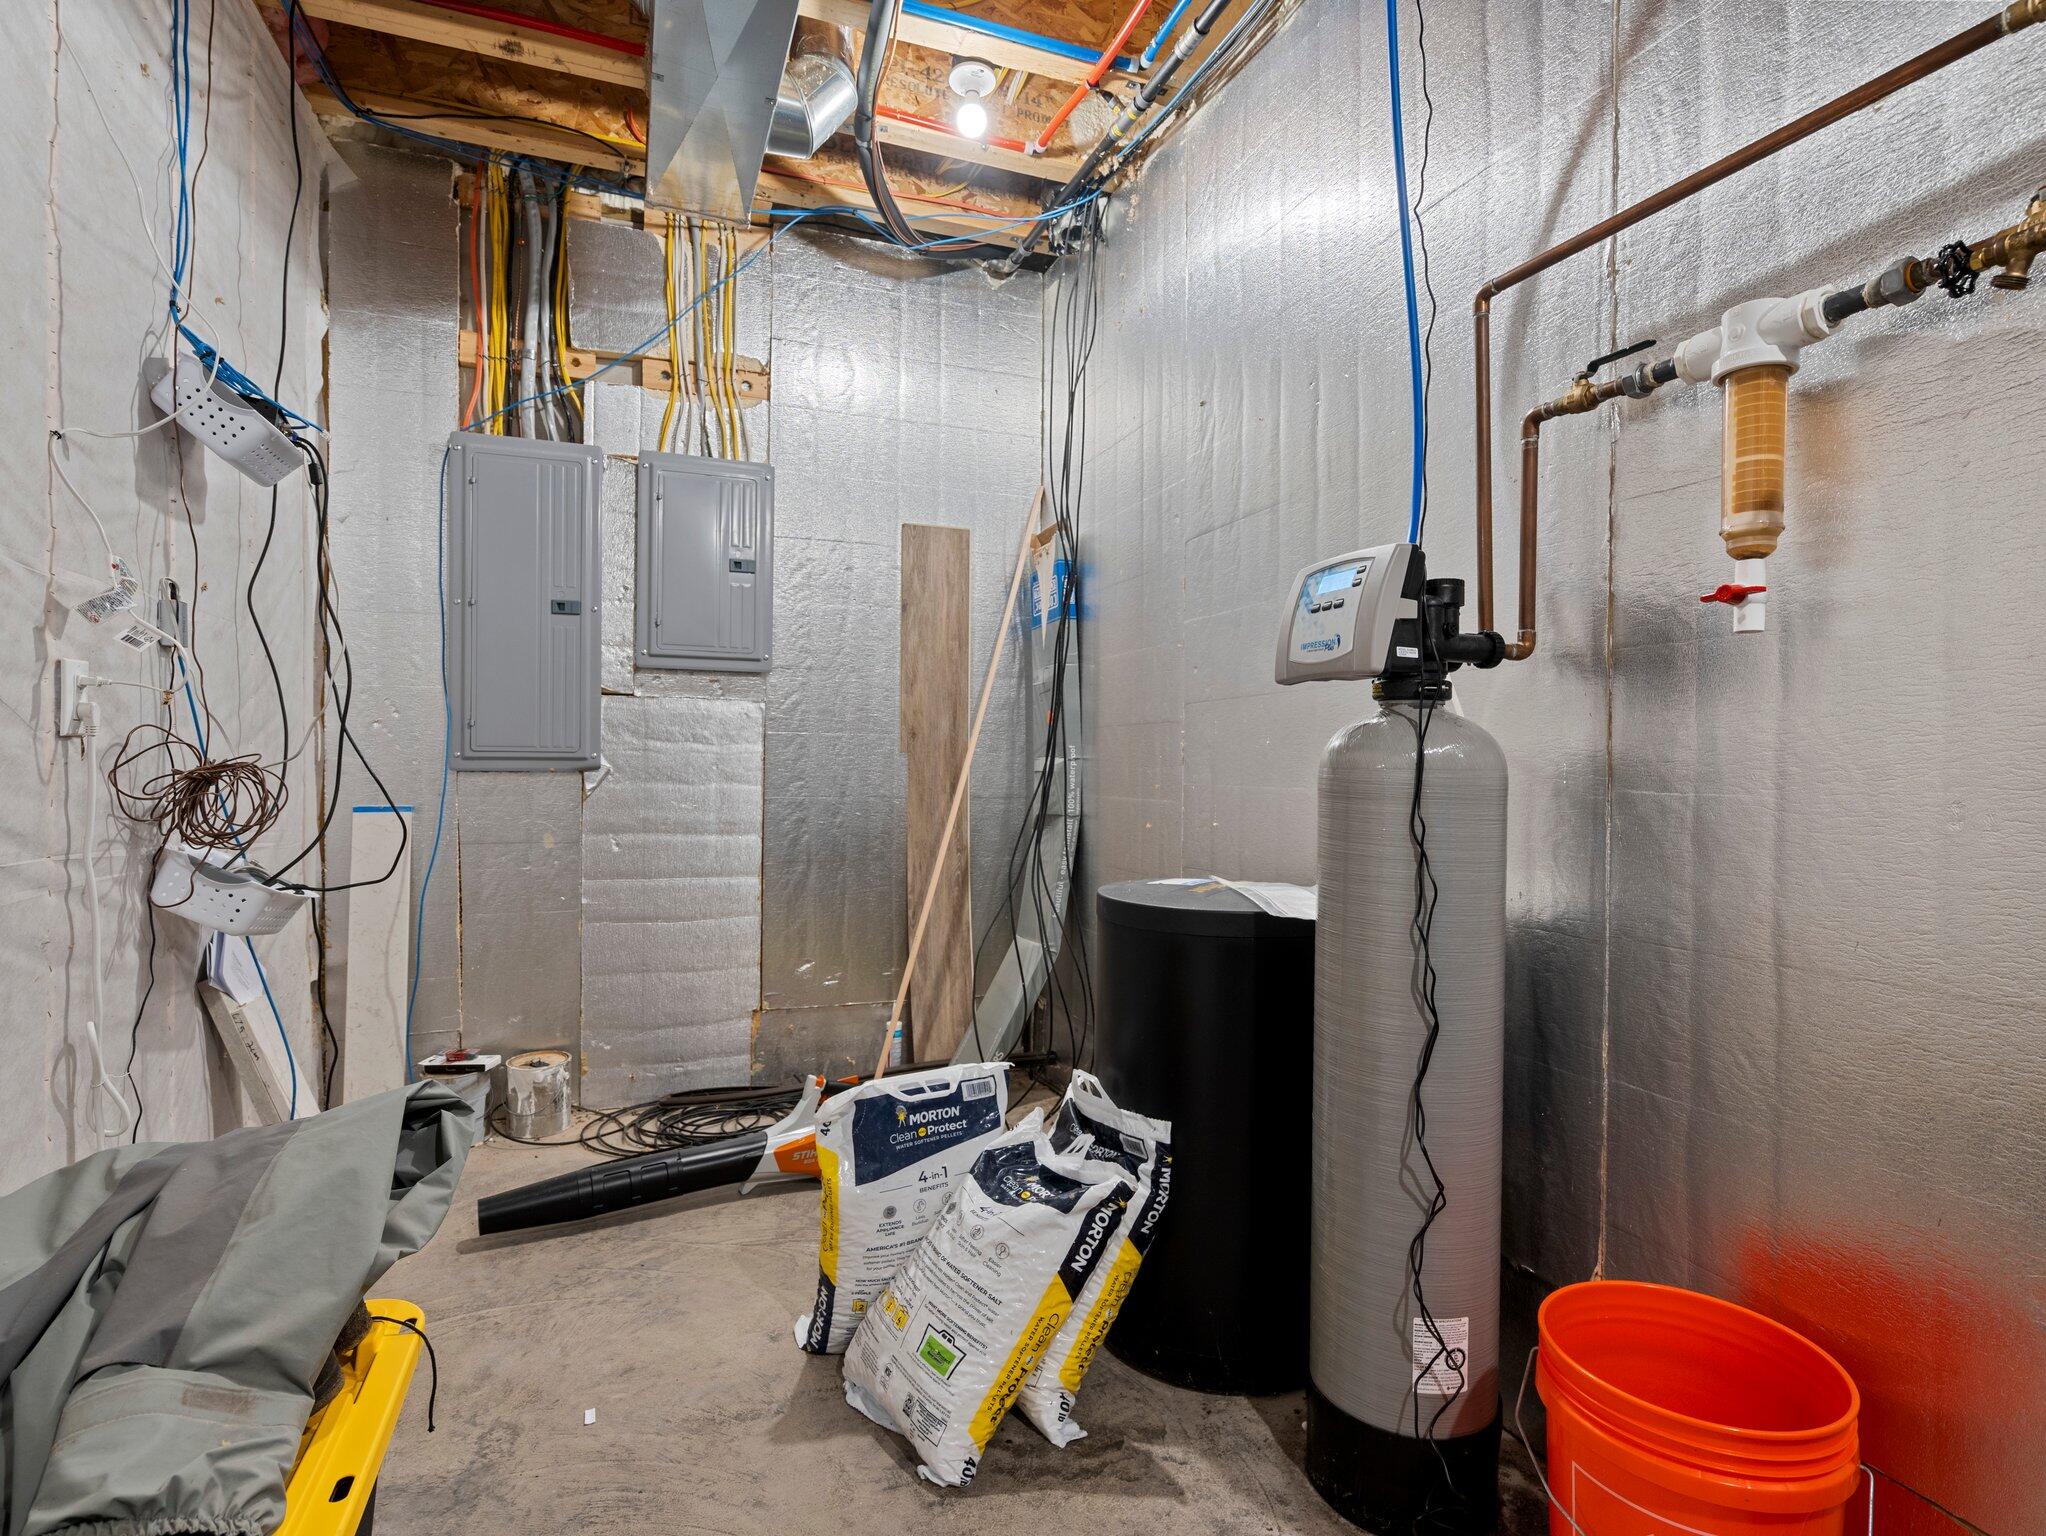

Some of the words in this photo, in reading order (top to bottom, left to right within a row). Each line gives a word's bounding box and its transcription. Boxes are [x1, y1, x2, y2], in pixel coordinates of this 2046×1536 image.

[909, 1106, 960, 1126] MORTON
[890, 1131, 918, 1144] Clean
[928, 1120, 967, 1134] Protect
[896, 1142, 913, 1151] WATER
[914, 1136, 940, 1146] SOFTENER
[941, 1131, 962, 1139] PELLETS
[919, 1166, 948, 1183] 4-in-1
[920, 1182, 948, 1193] BENEFITS
[1140, 1167, 1172, 1235] MORTON
[866, 1244, 898, 1252] AMERICA'S
[1070, 1201, 1119, 1274] MORTON
[960, 1272, 988, 1297] SOFTENER
[986, 1292, 1002, 1306] SALT
[810, 1287, 829, 1350] MORTON
[1028, 1317, 1045, 1342] WATER
[1031, 1313, 1060, 1353] Clean
[1078, 1319, 1112, 1371] Protect
[1004, 1342, 1029, 1383] SOFTENER
[986, 1382, 1006, 1412] PELLETS
[990, 1366, 1029, 1424] Protect
[962, 1456, 977, 1480] 40
